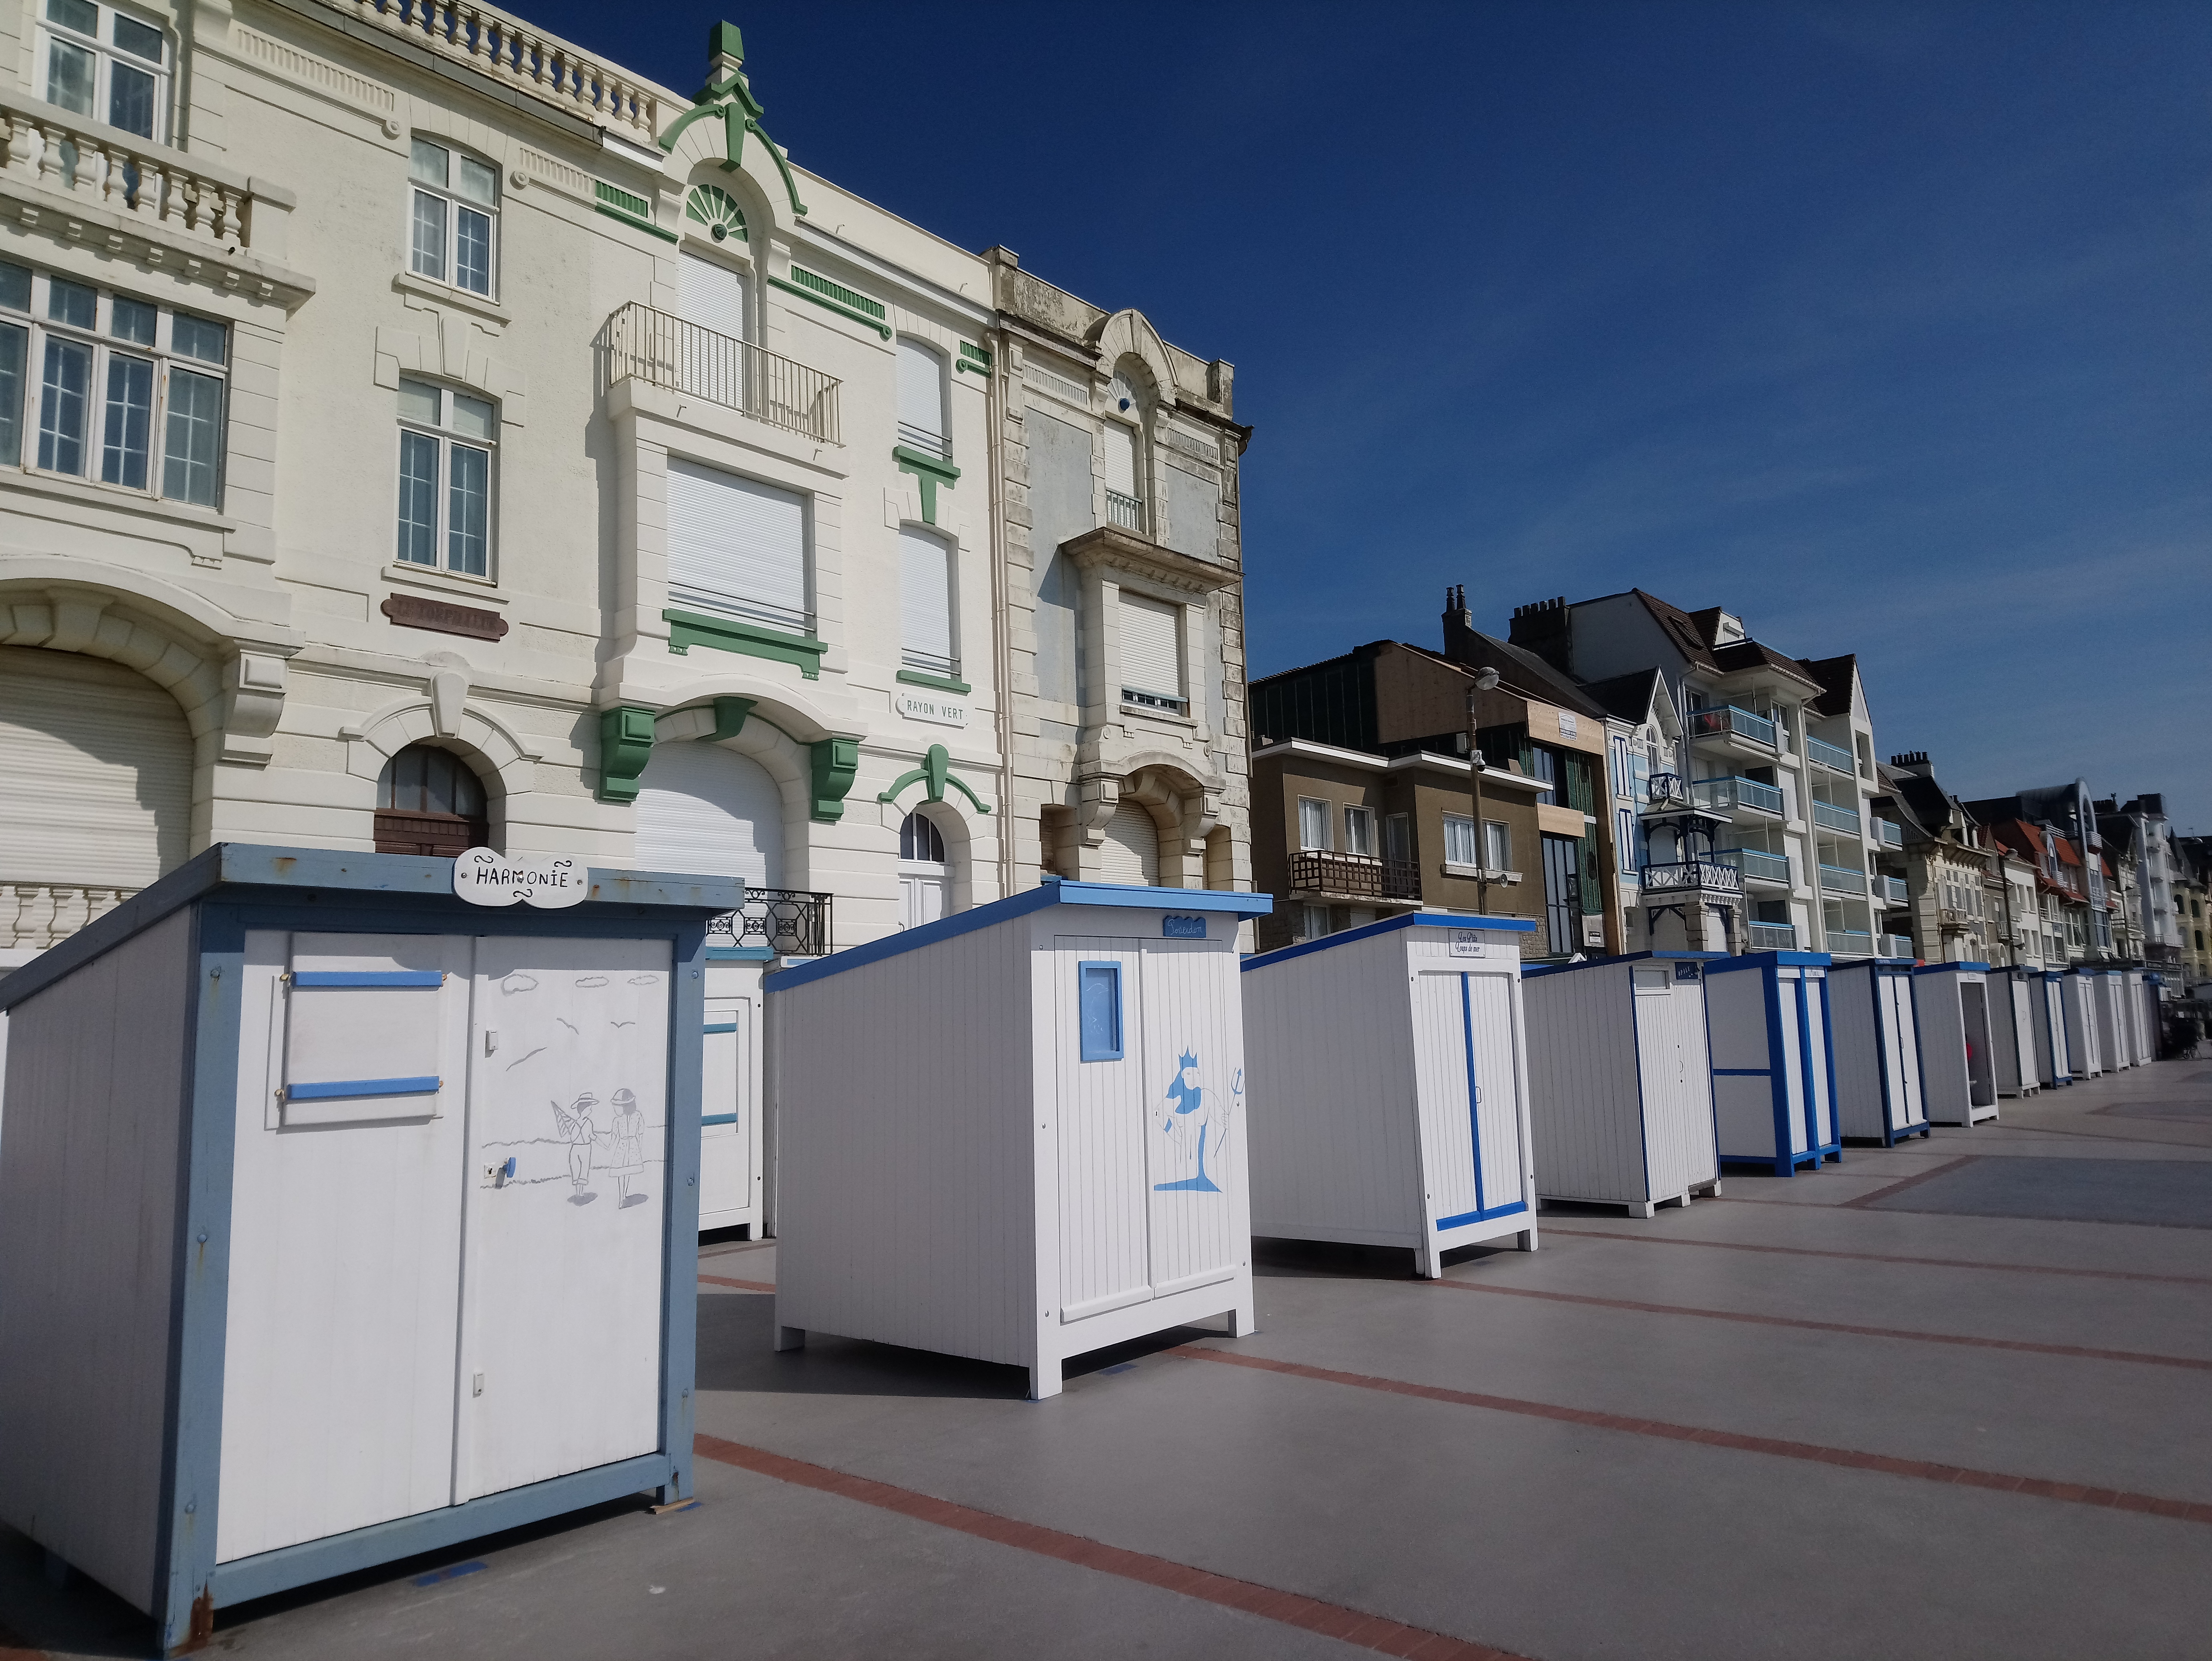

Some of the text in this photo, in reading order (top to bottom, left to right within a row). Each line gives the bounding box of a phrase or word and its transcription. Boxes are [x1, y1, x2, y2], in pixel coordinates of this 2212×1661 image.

[907, 700, 963, 719] RAYON VERT
[476, 867, 568, 887] HARMONIE
[1458, 932, 1466, 943] Les
[1455, 941, 1467, 954] Loups
[1468, 943, 1472, 952] de
